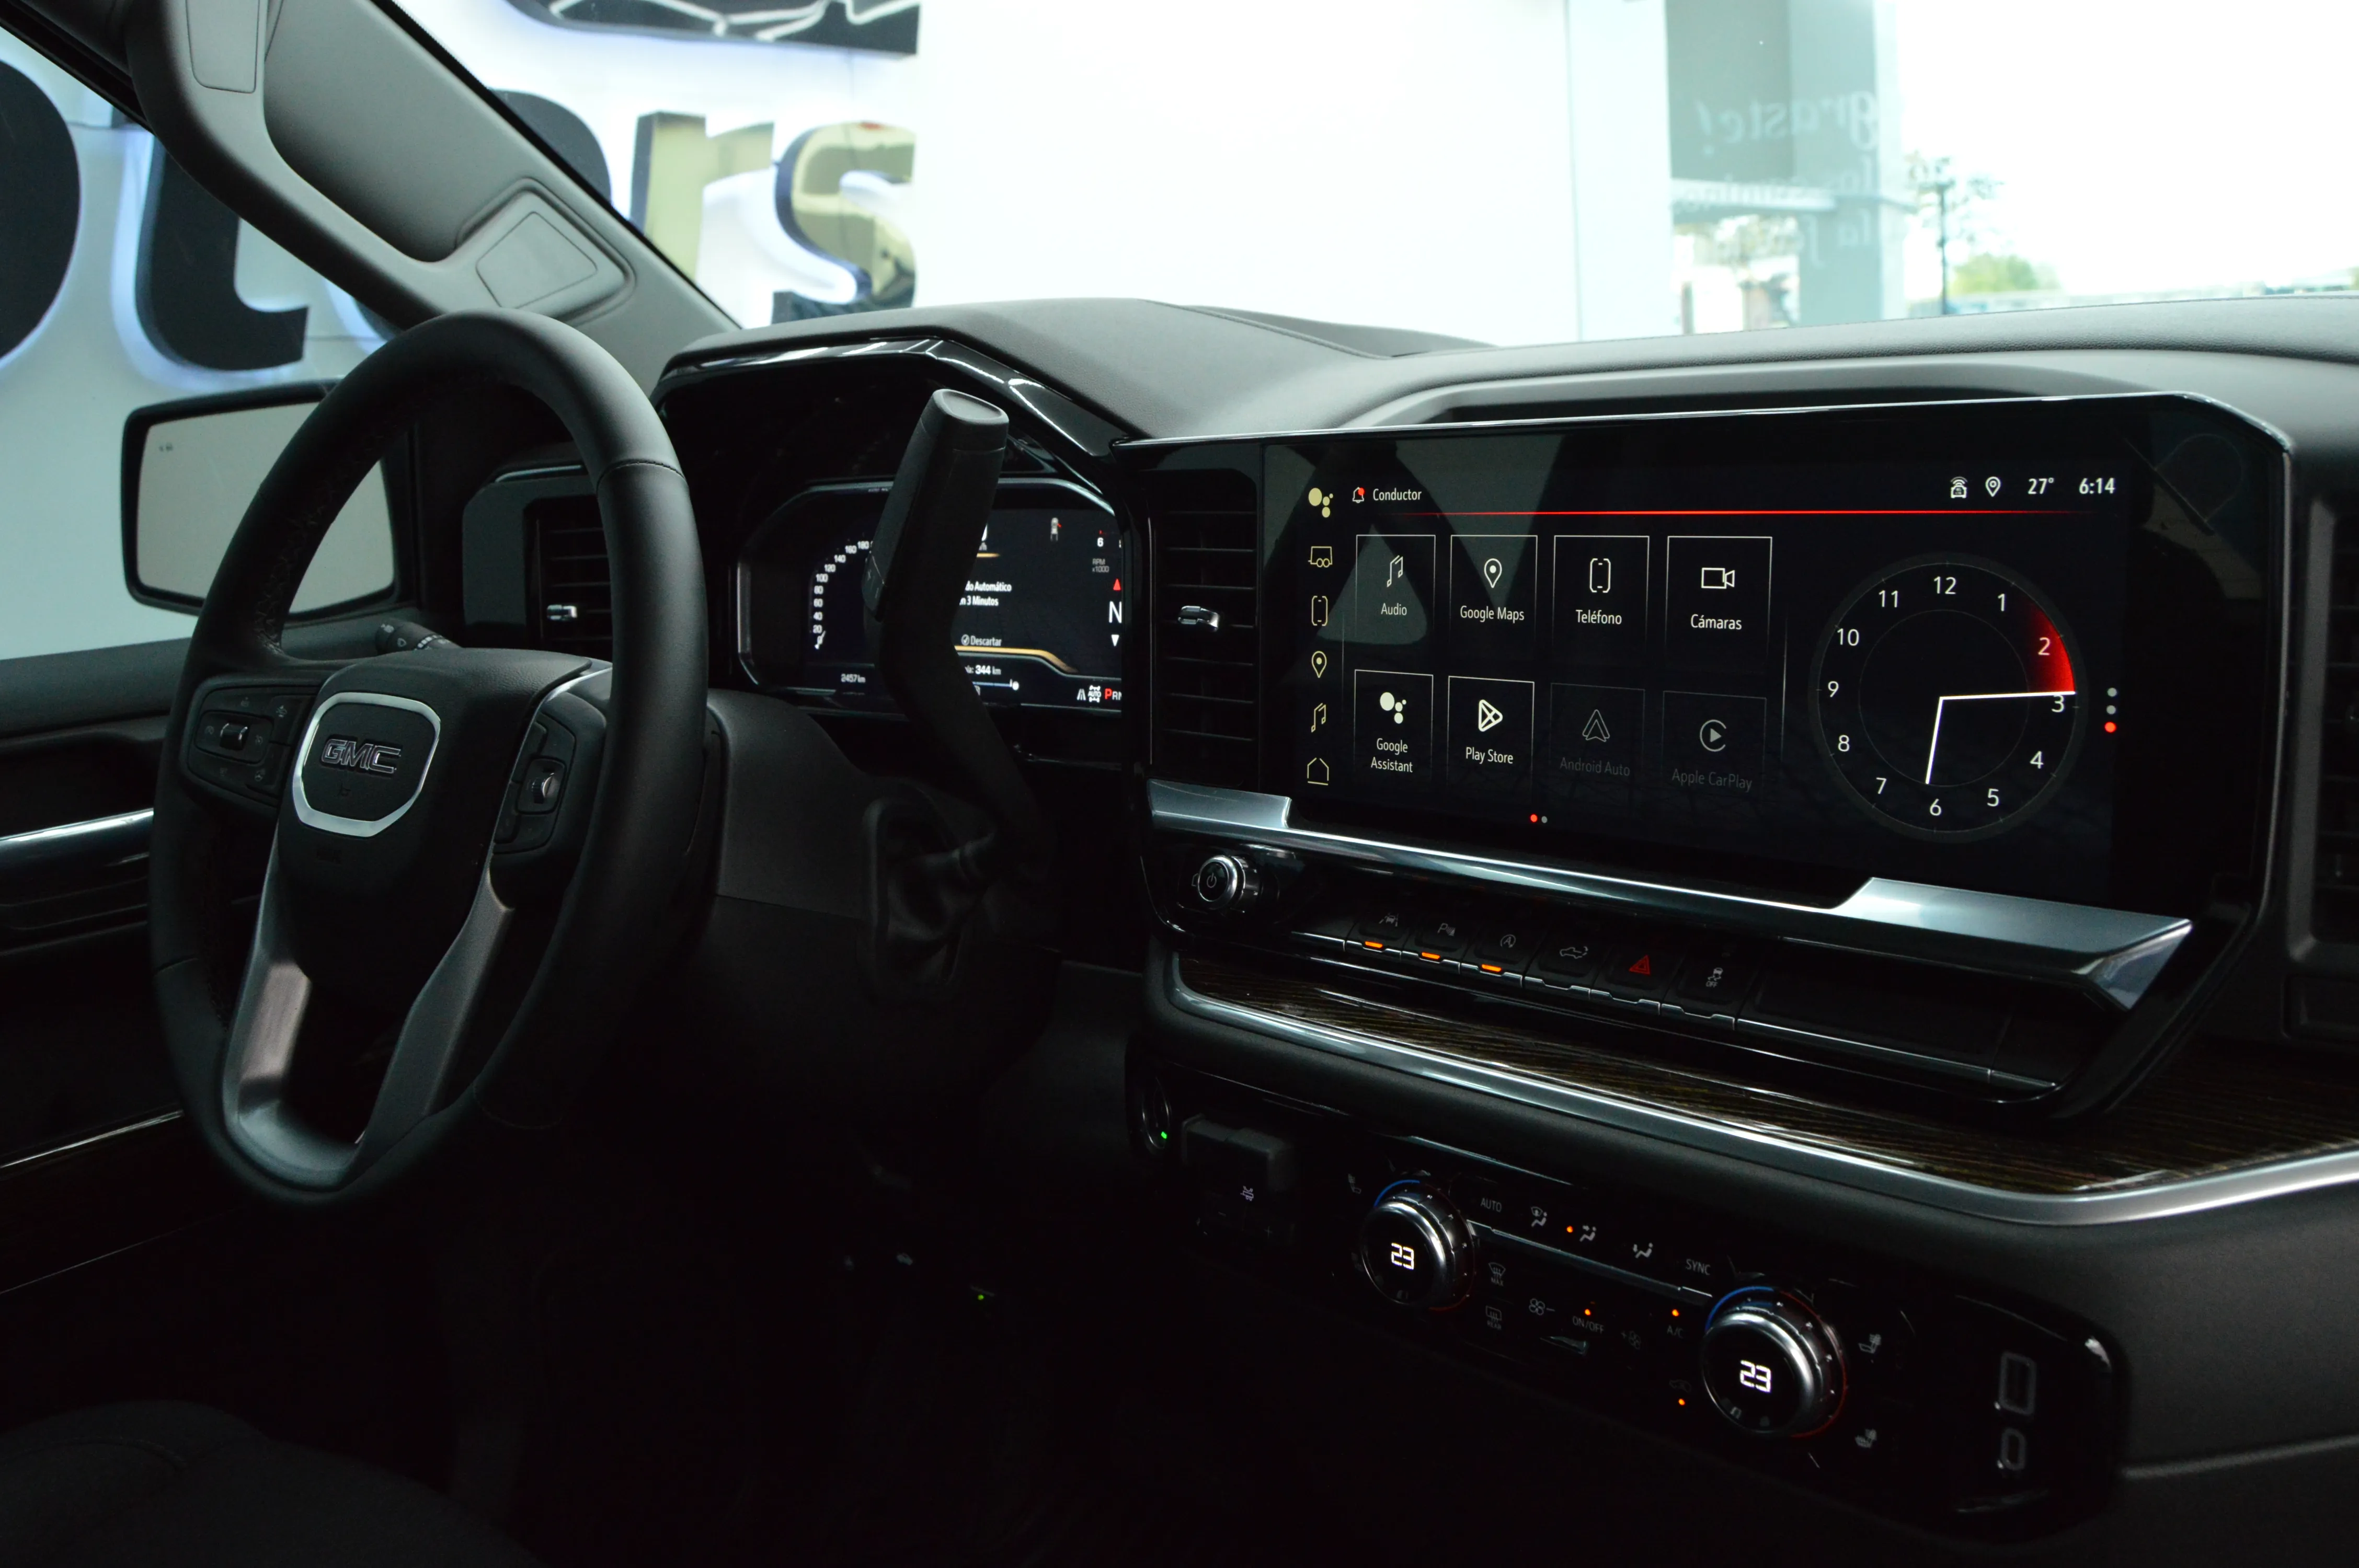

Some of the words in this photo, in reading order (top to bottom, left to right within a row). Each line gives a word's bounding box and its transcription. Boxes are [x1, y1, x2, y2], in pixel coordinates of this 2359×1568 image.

[1372, 487, 1422, 501] Conductor
[2079, 477, 2116, 494] 6:14
[1097, 537, 1104, 547] 6
[834, 554, 846, 563] 140
[824, 563, 836, 573] 120
[816, 573, 829, 583] 100
[974, 581, 1012, 592] Automático
[1933, 576, 1956, 595] 12
[814, 585, 824, 595] 80
[967, 595, 971, 606] 3
[972, 595, 999, 607] Minutos
[1879, 590, 1898, 608] 11
[1997, 593, 2006, 612] 1
[813, 612, 823, 621] 40
[1108, 601, 1122, 624] N
[1380, 603, 1407, 616] Audio
[1460, 605, 1494, 622] Google
[1497, 606, 1525, 624] Maps
[1575, 608, 1622, 625] Teléfono
[812, 624, 822, 634] 20
[1690, 614, 1742, 630] Cámaras
[970, 635, 1002, 647] Descartar
[1837, 628, 1860, 646] 10
[2037, 637, 2051, 656] 2
[975, 664, 991, 675] 344
[992, 665, 1001, 675] km
[1828, 681, 1839, 698] 9
[2051, 695, 2065, 713] 3
[1377, 737, 1408, 755] Google
[1838, 734, 1850, 752] 8
[321, 739, 402, 775] GMC
[1465, 746, 1485, 764] Play
[1488, 749, 1514, 764] Store
[2030, 751, 2044, 769] 4
[1370, 756, 1413, 773] Assistant
[1560, 757, 1601, 774] Android
[1605, 760, 1630, 777] Auto
[1671, 768, 1705, 786] Apple
[1708, 771, 1753, 791] CarPlay
[1876, 777, 1887, 794] 7
[1987, 788, 1999, 807] 5
[1929, 798, 1942, 816] 6
[1480, 1197, 1503, 1213] AUTO
[1391, 1242, 1415, 1271] 23
[1685, 1258, 1711, 1276] SYNC
[1491, 1276, 1504, 1287] MAX
[1487, 1319, 1502, 1331] REAR
[1572, 1316, 1605, 1335] ON/OFF
[1666, 1324, 1684, 1339] A/C
[1739, 1360, 1772, 1393] 23
